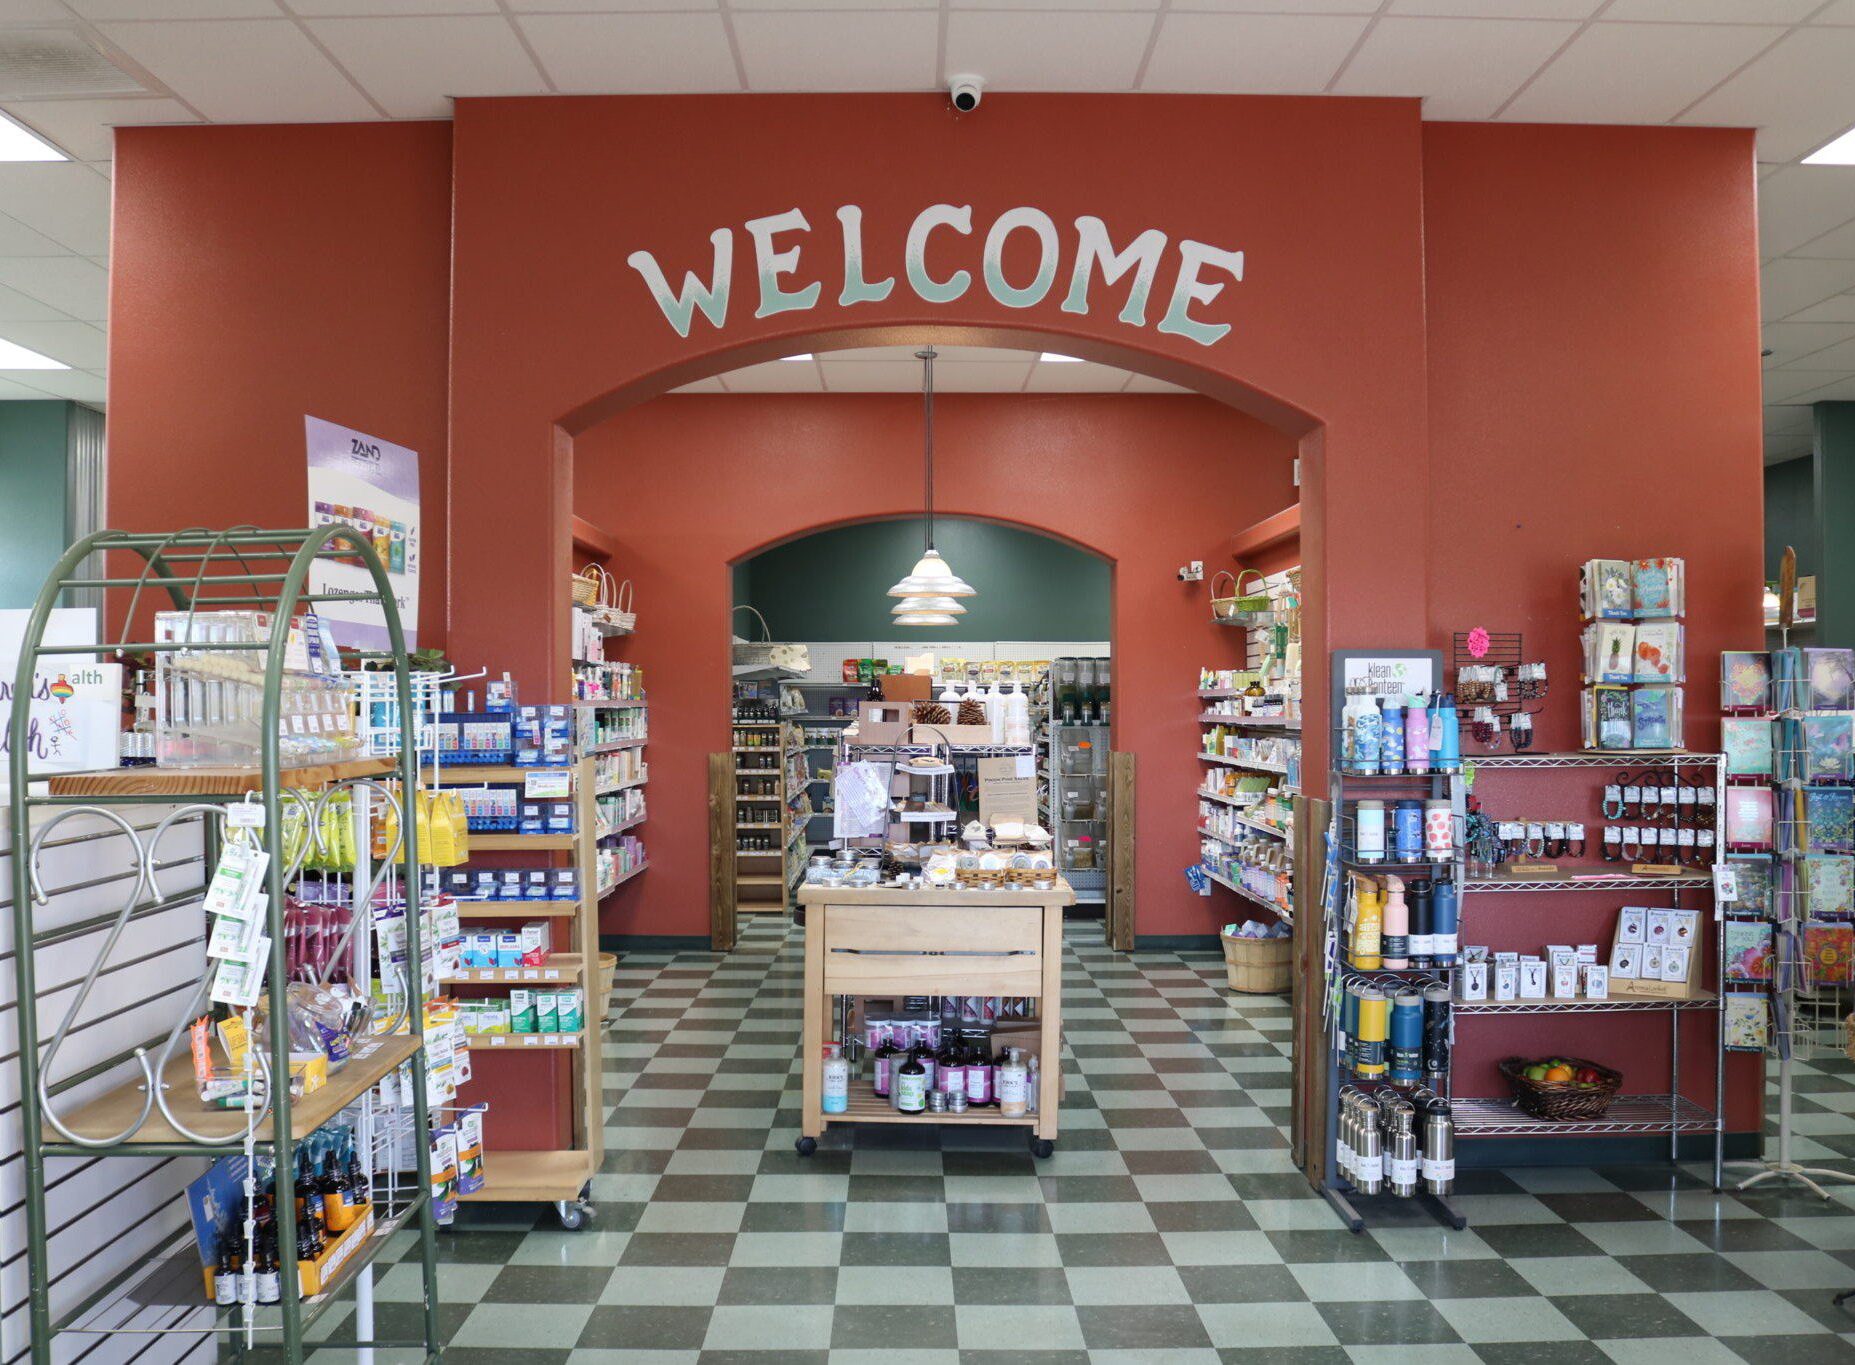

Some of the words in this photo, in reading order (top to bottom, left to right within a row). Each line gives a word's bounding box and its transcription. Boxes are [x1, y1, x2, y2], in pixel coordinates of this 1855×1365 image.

[627, 203, 1245, 347] WELCOME
[351, 438, 381, 461] ZAND
[1368, 661, 1392, 679] klean
